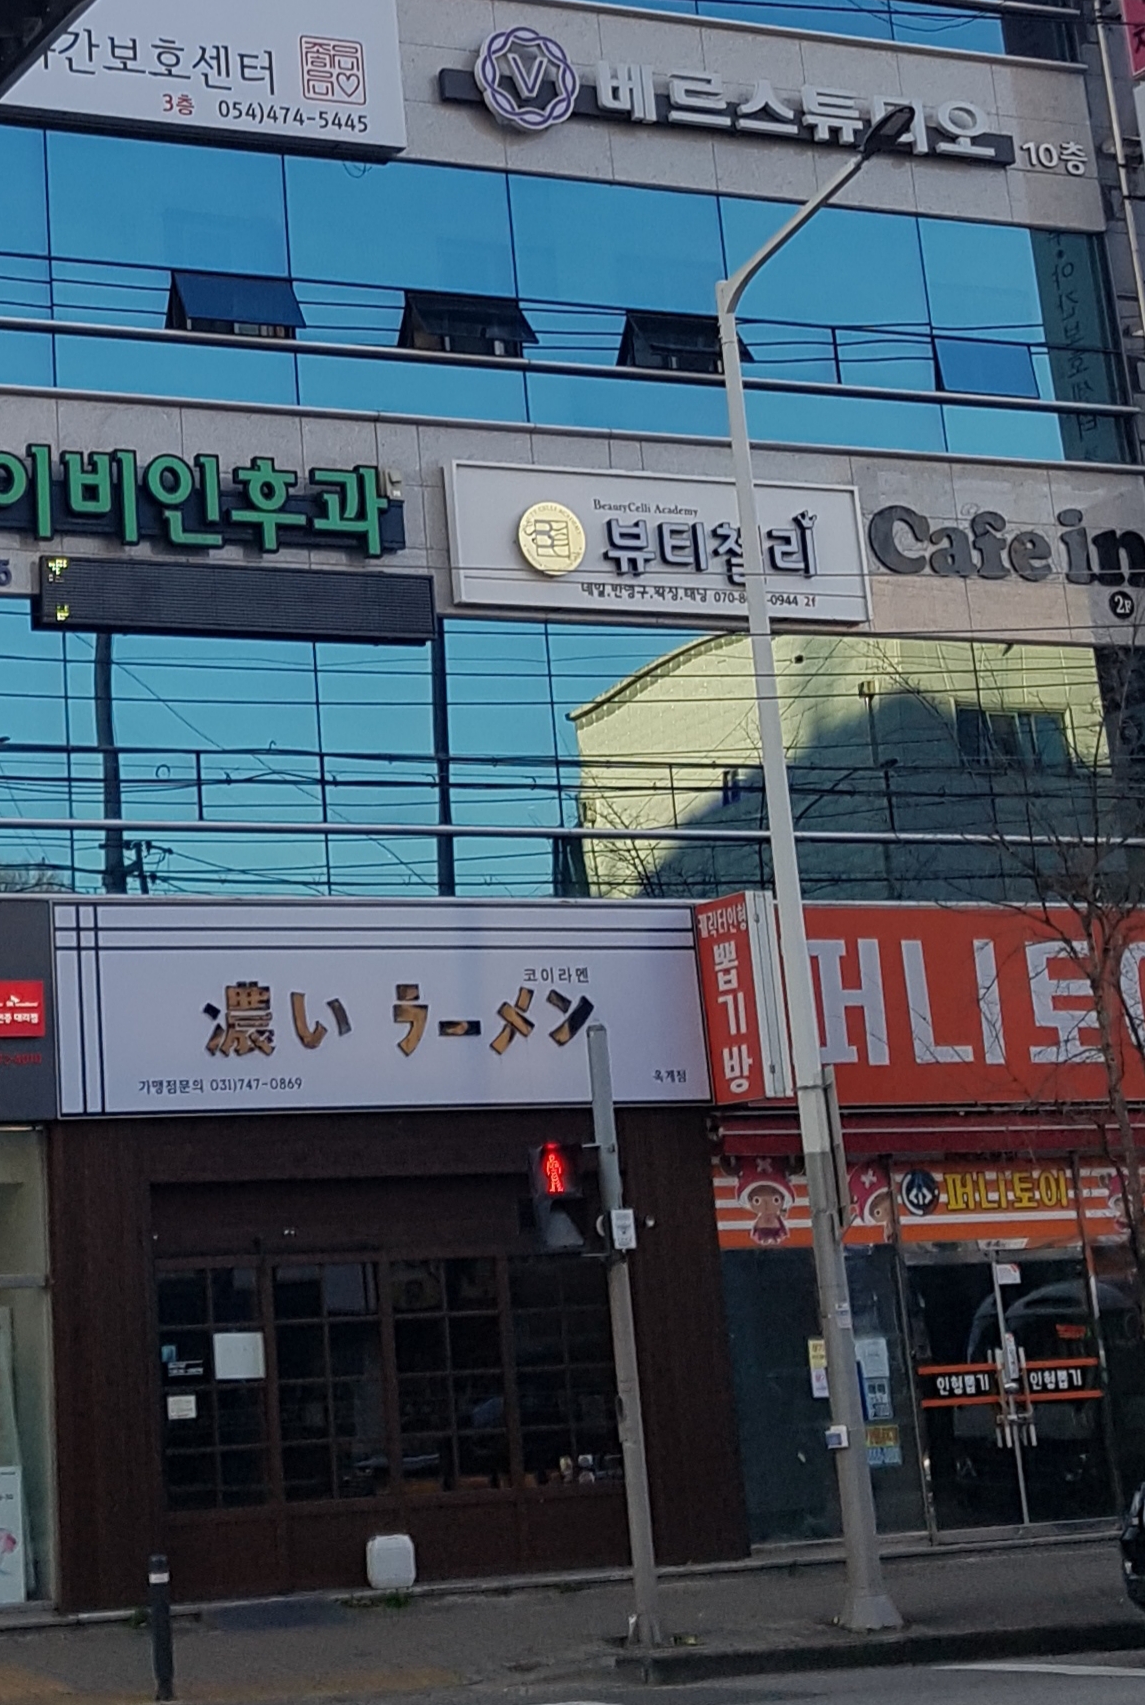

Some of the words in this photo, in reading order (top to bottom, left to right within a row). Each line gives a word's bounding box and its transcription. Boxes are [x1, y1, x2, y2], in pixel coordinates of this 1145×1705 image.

[161, 92, 195, 118] 3층
[218, 98, 369, 134] 054)474-5445
[1022, 141, 1089, 177] 10층
[653, 501, 699, 518] Academy
[713, 591, 800, 608] 070-8-0944
[1115, 594, 1133, 615] 2F
[522, 966, 590, 985] 코이라멘
[392, 982, 595, 1057] ラーメン
[713, 939, 753, 1094] 뽑기방
[138, 1076, 204, 1095] 가맹점문의
[209, 1074, 304, 1094] 031)747-0869
[944, 1169, 1069, 1211] 퍼니토이
[936, 1373, 990, 1396] 인형뽑기
[1029, 1368, 1083, 1391] 인형뽑기
